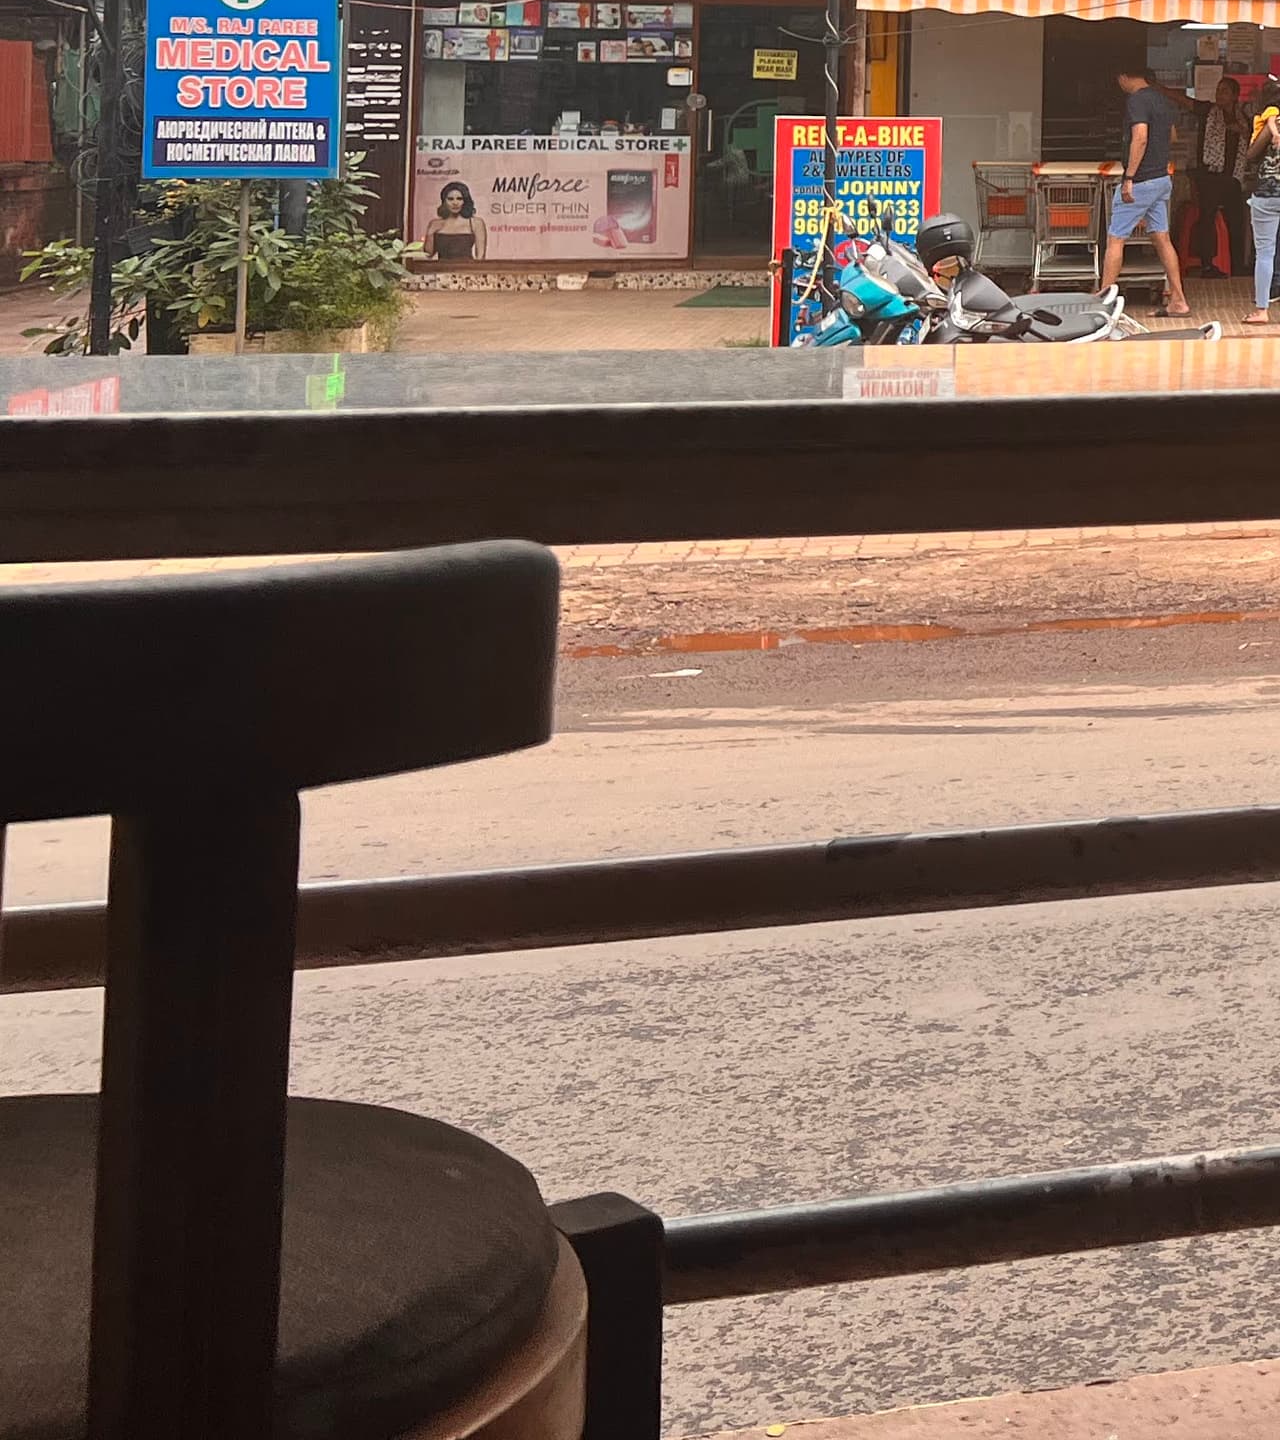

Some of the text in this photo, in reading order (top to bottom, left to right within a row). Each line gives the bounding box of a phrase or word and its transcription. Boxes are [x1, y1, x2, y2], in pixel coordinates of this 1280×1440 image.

[170, 16, 318, 36] M/S. RAJ PAREE
[156, 38, 330, 72] MEDICAL
[177, 76, 307, 109] STORE
[268, 122, 315, 140] АПТЕКА
[316, 125, 326, 140] &
[274, 143, 316, 162] ЛАВКА
[432, 138, 670, 151] RAJ PAREE MEDICAL STORE
[838, 151, 881, 163] TYPES
[887, 151, 905, 163] OF
[836, 165, 912, 177] WHEELERS
[838, 180, 920, 195] JOHNNY
[490, 202, 589, 215] SUPER THIN
